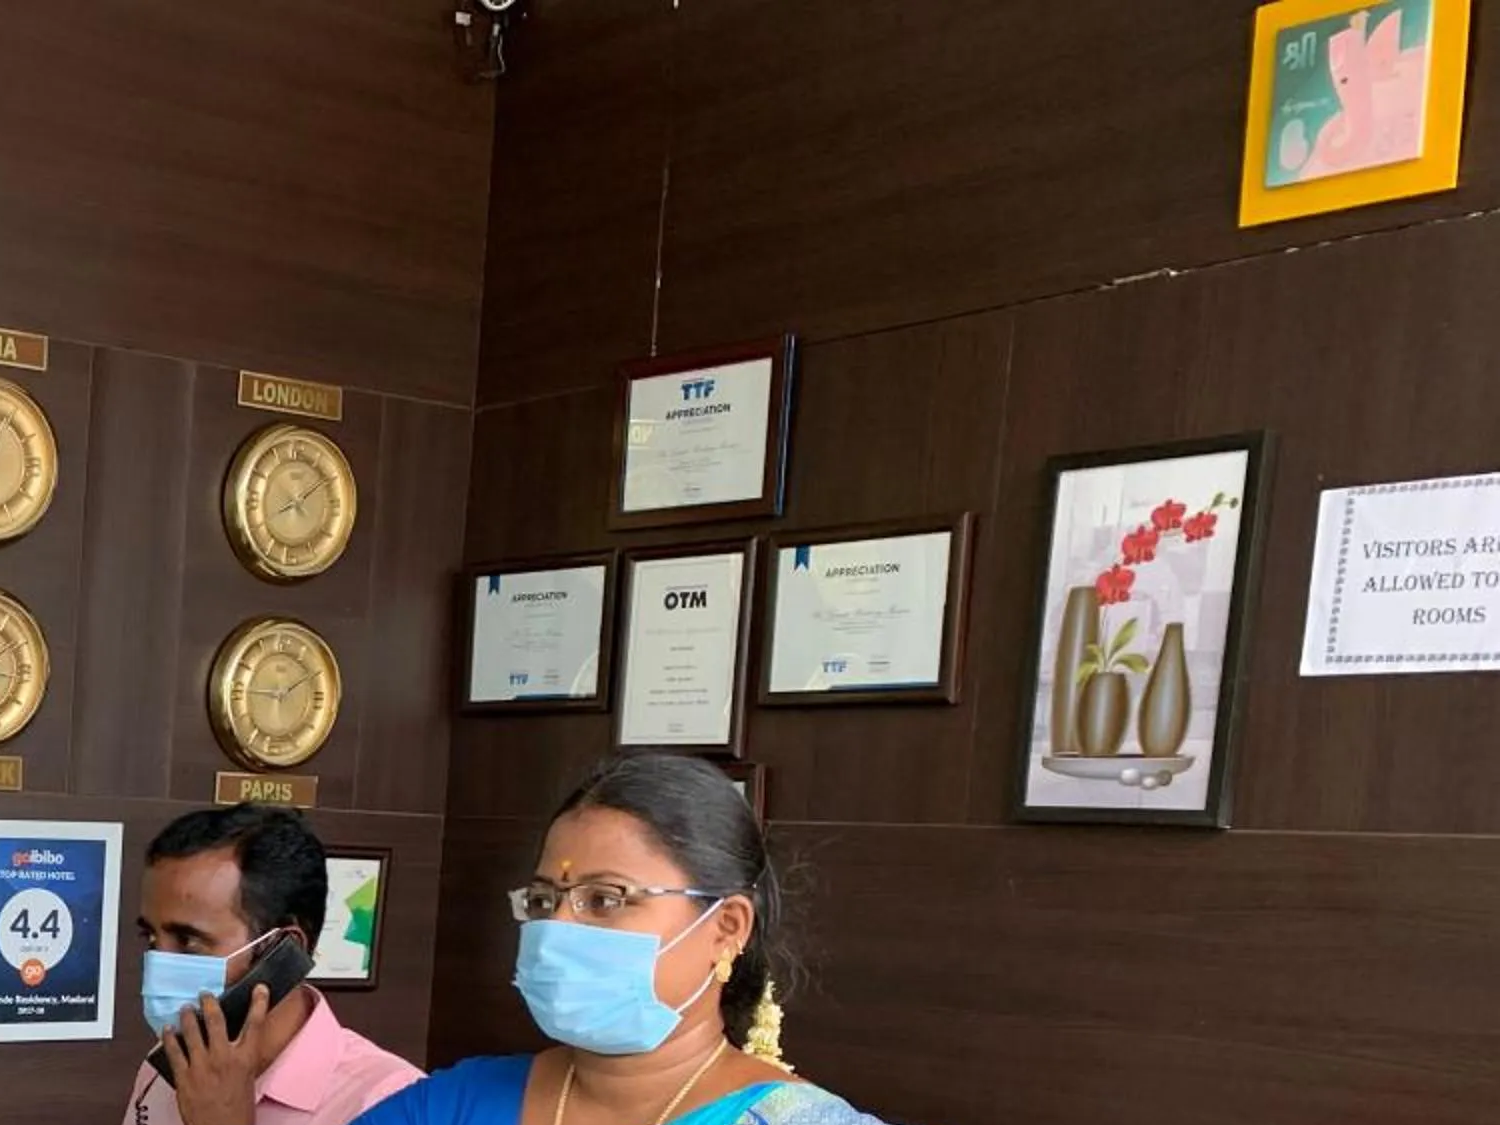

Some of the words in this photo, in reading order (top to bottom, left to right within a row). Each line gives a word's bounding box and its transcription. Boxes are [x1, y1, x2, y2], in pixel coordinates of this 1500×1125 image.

[252, 379, 328, 413] LONDON
[681, 380, 715, 400] TTF
[665, 403, 731, 420] APPRECIATION
[1363, 538, 1457, 559] VISITORS
[1462, 535, 1500, 555] AR
[825, 563, 900, 578] APPRECIATION
[1362, 570, 1465, 592] ALLOWED
[1470, 570, 1499, 588] TO
[663, 590, 708, 611] OTM
[1412, 606, 1487, 626] ROOMS
[822, 660, 847, 673] TTF
[240, 779, 293, 801] PARIS
[12, 850, 65, 867] goibibo
[9, 908, 61, 939] 4.4
